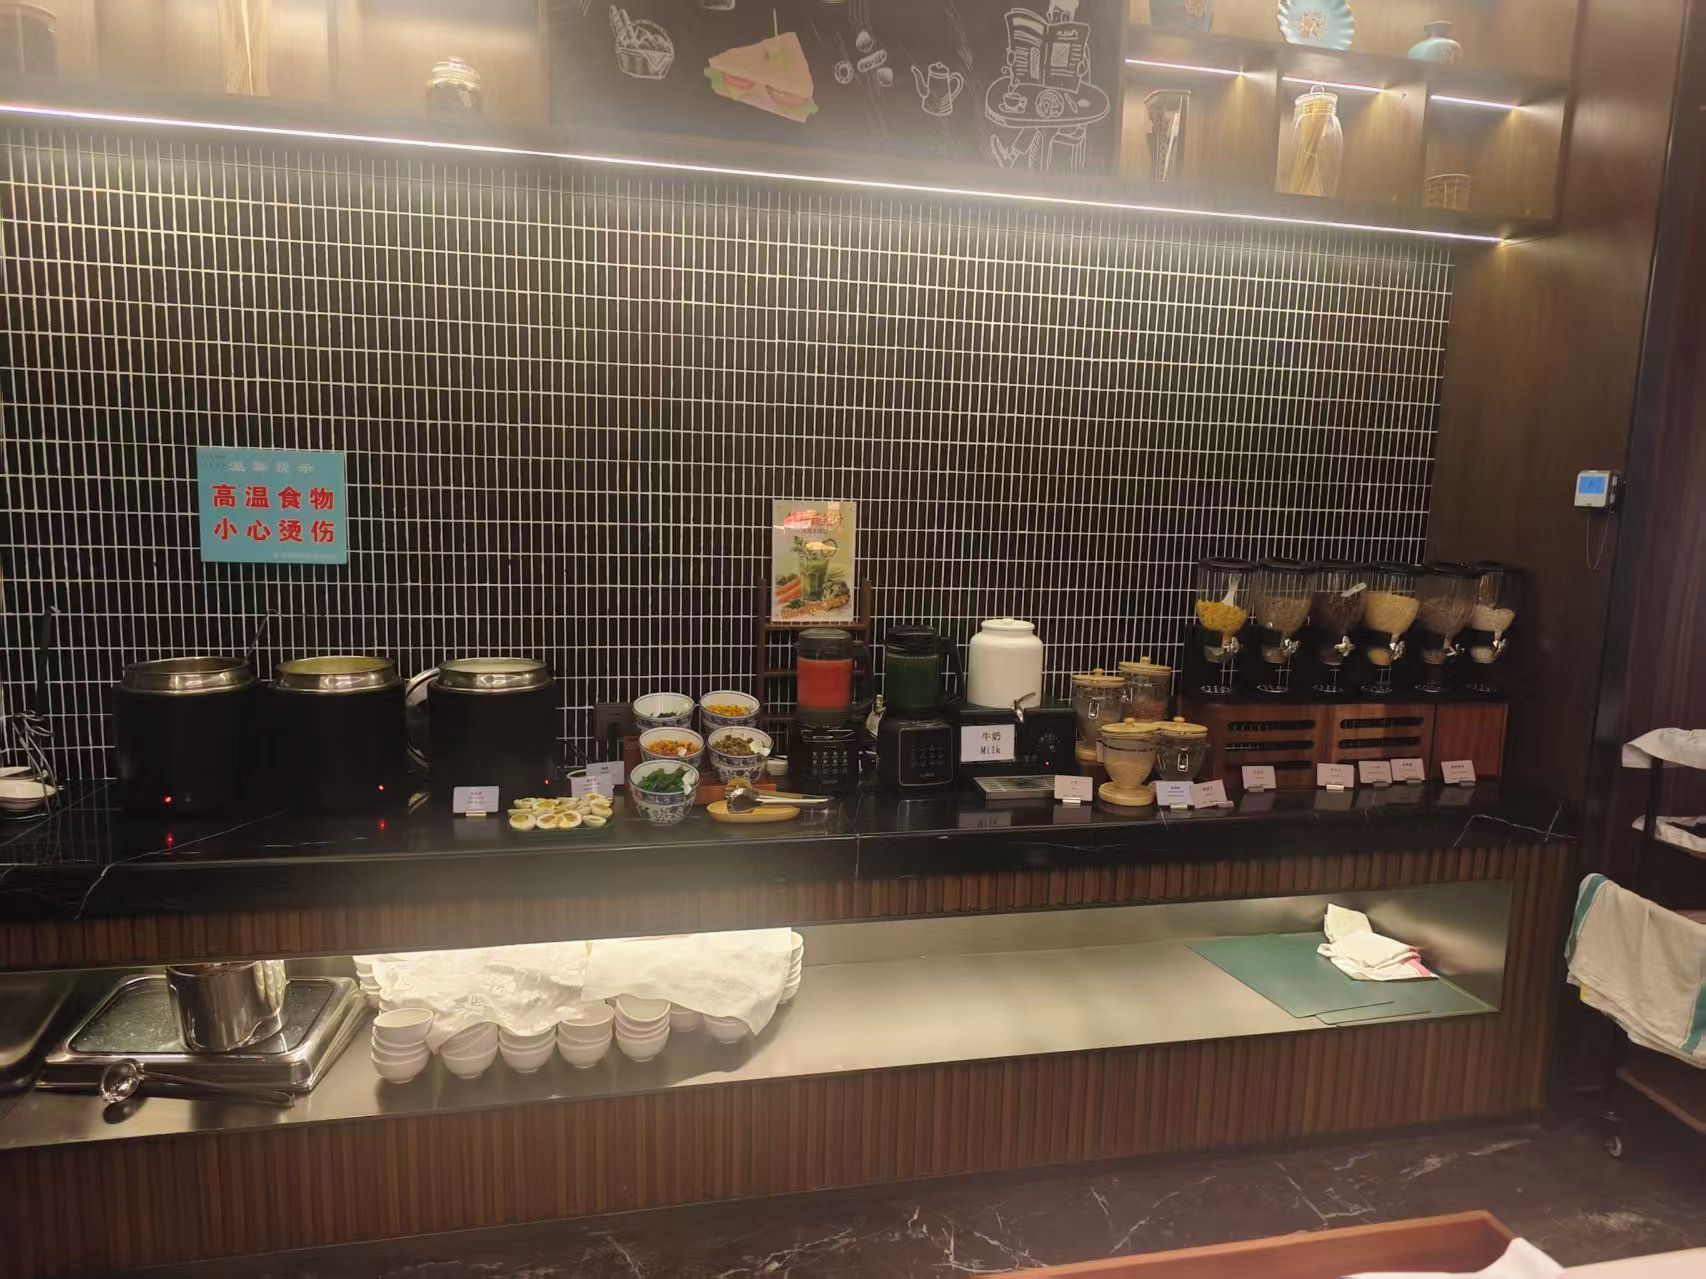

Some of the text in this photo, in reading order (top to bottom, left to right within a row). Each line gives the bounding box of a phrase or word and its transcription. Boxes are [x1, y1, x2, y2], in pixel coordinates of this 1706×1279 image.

[211, 483, 335, 510] 高温食物
[213, 517, 335, 544] 小心烫伤
[981, 731, 1001, 741] 牛奶
[980, 745, 1001, 754] Milk
